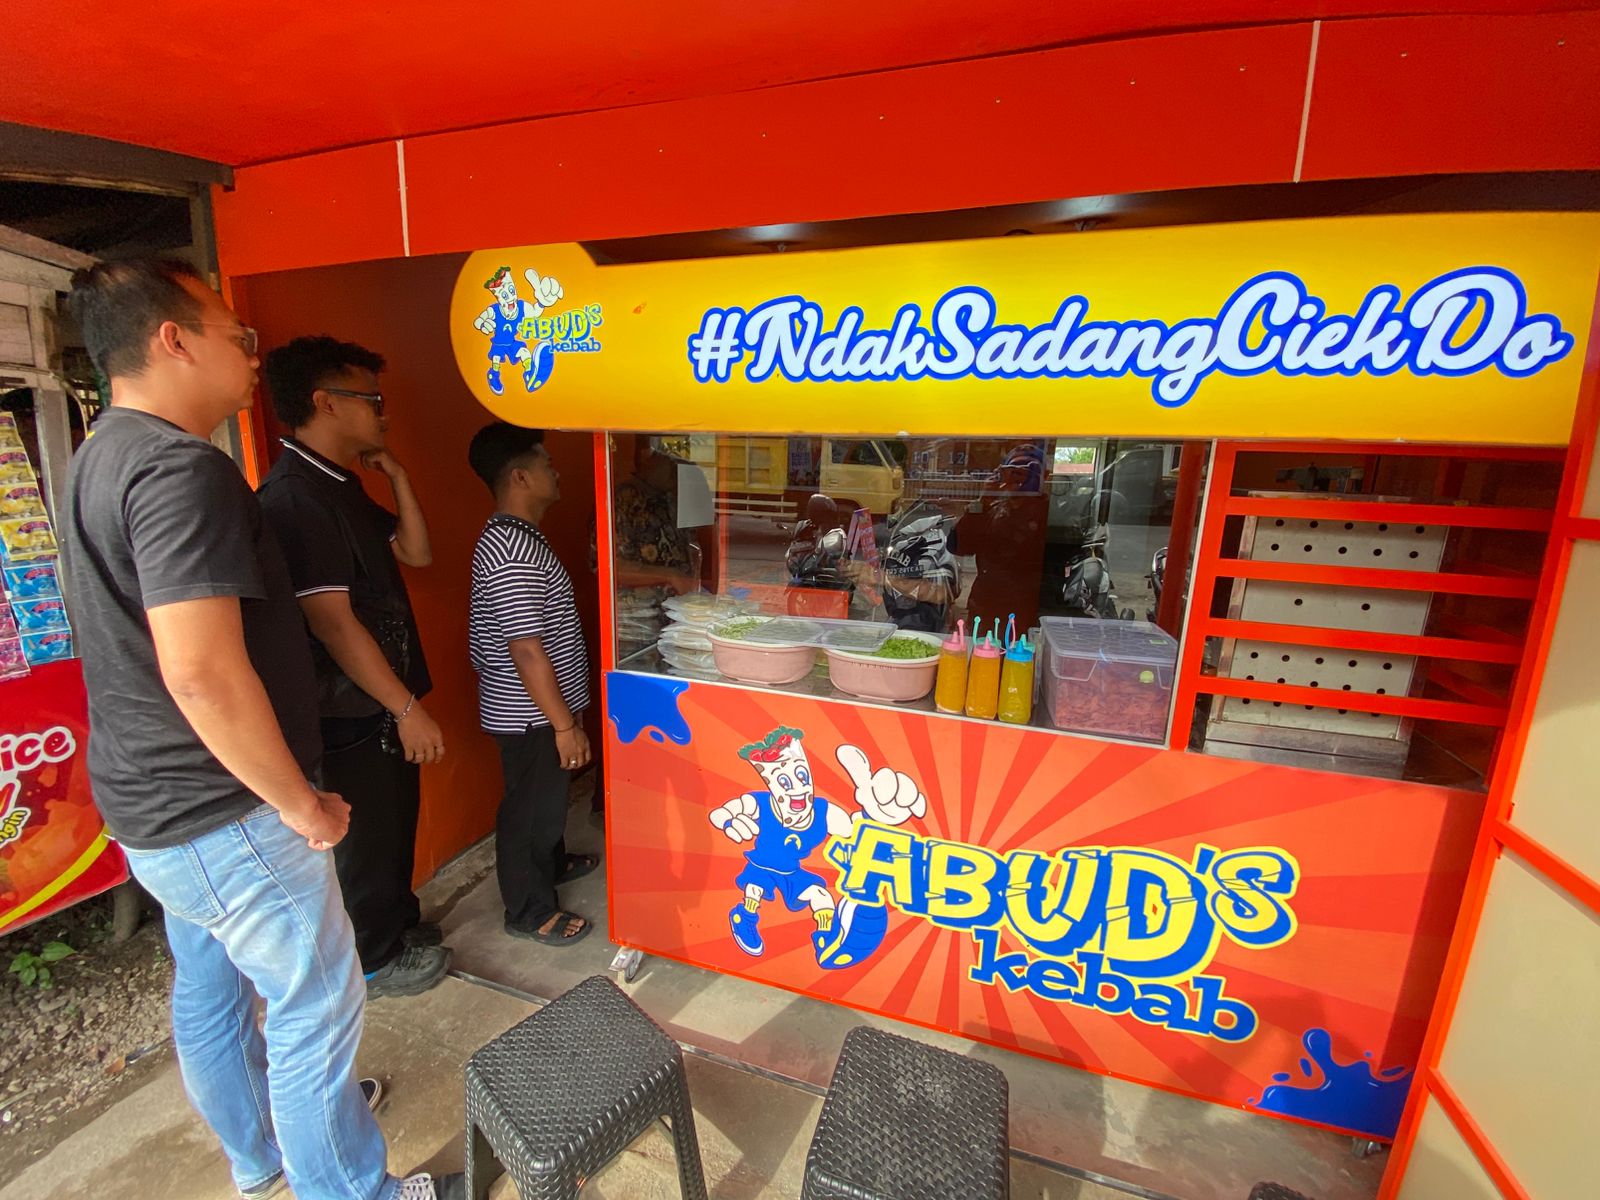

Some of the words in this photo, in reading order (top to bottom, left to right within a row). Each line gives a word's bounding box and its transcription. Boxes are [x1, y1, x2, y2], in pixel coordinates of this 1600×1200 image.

[518, 304, 603, 341] ABUD'S
[550, 337, 602, 352] kebab
[689, 267, 1573, 406] #NdakSadangCiekDo
[0, 728, 75, 772] ice
[830, 821, 1298, 979] ABUD'S
[968, 929, 1257, 1042] kebab
